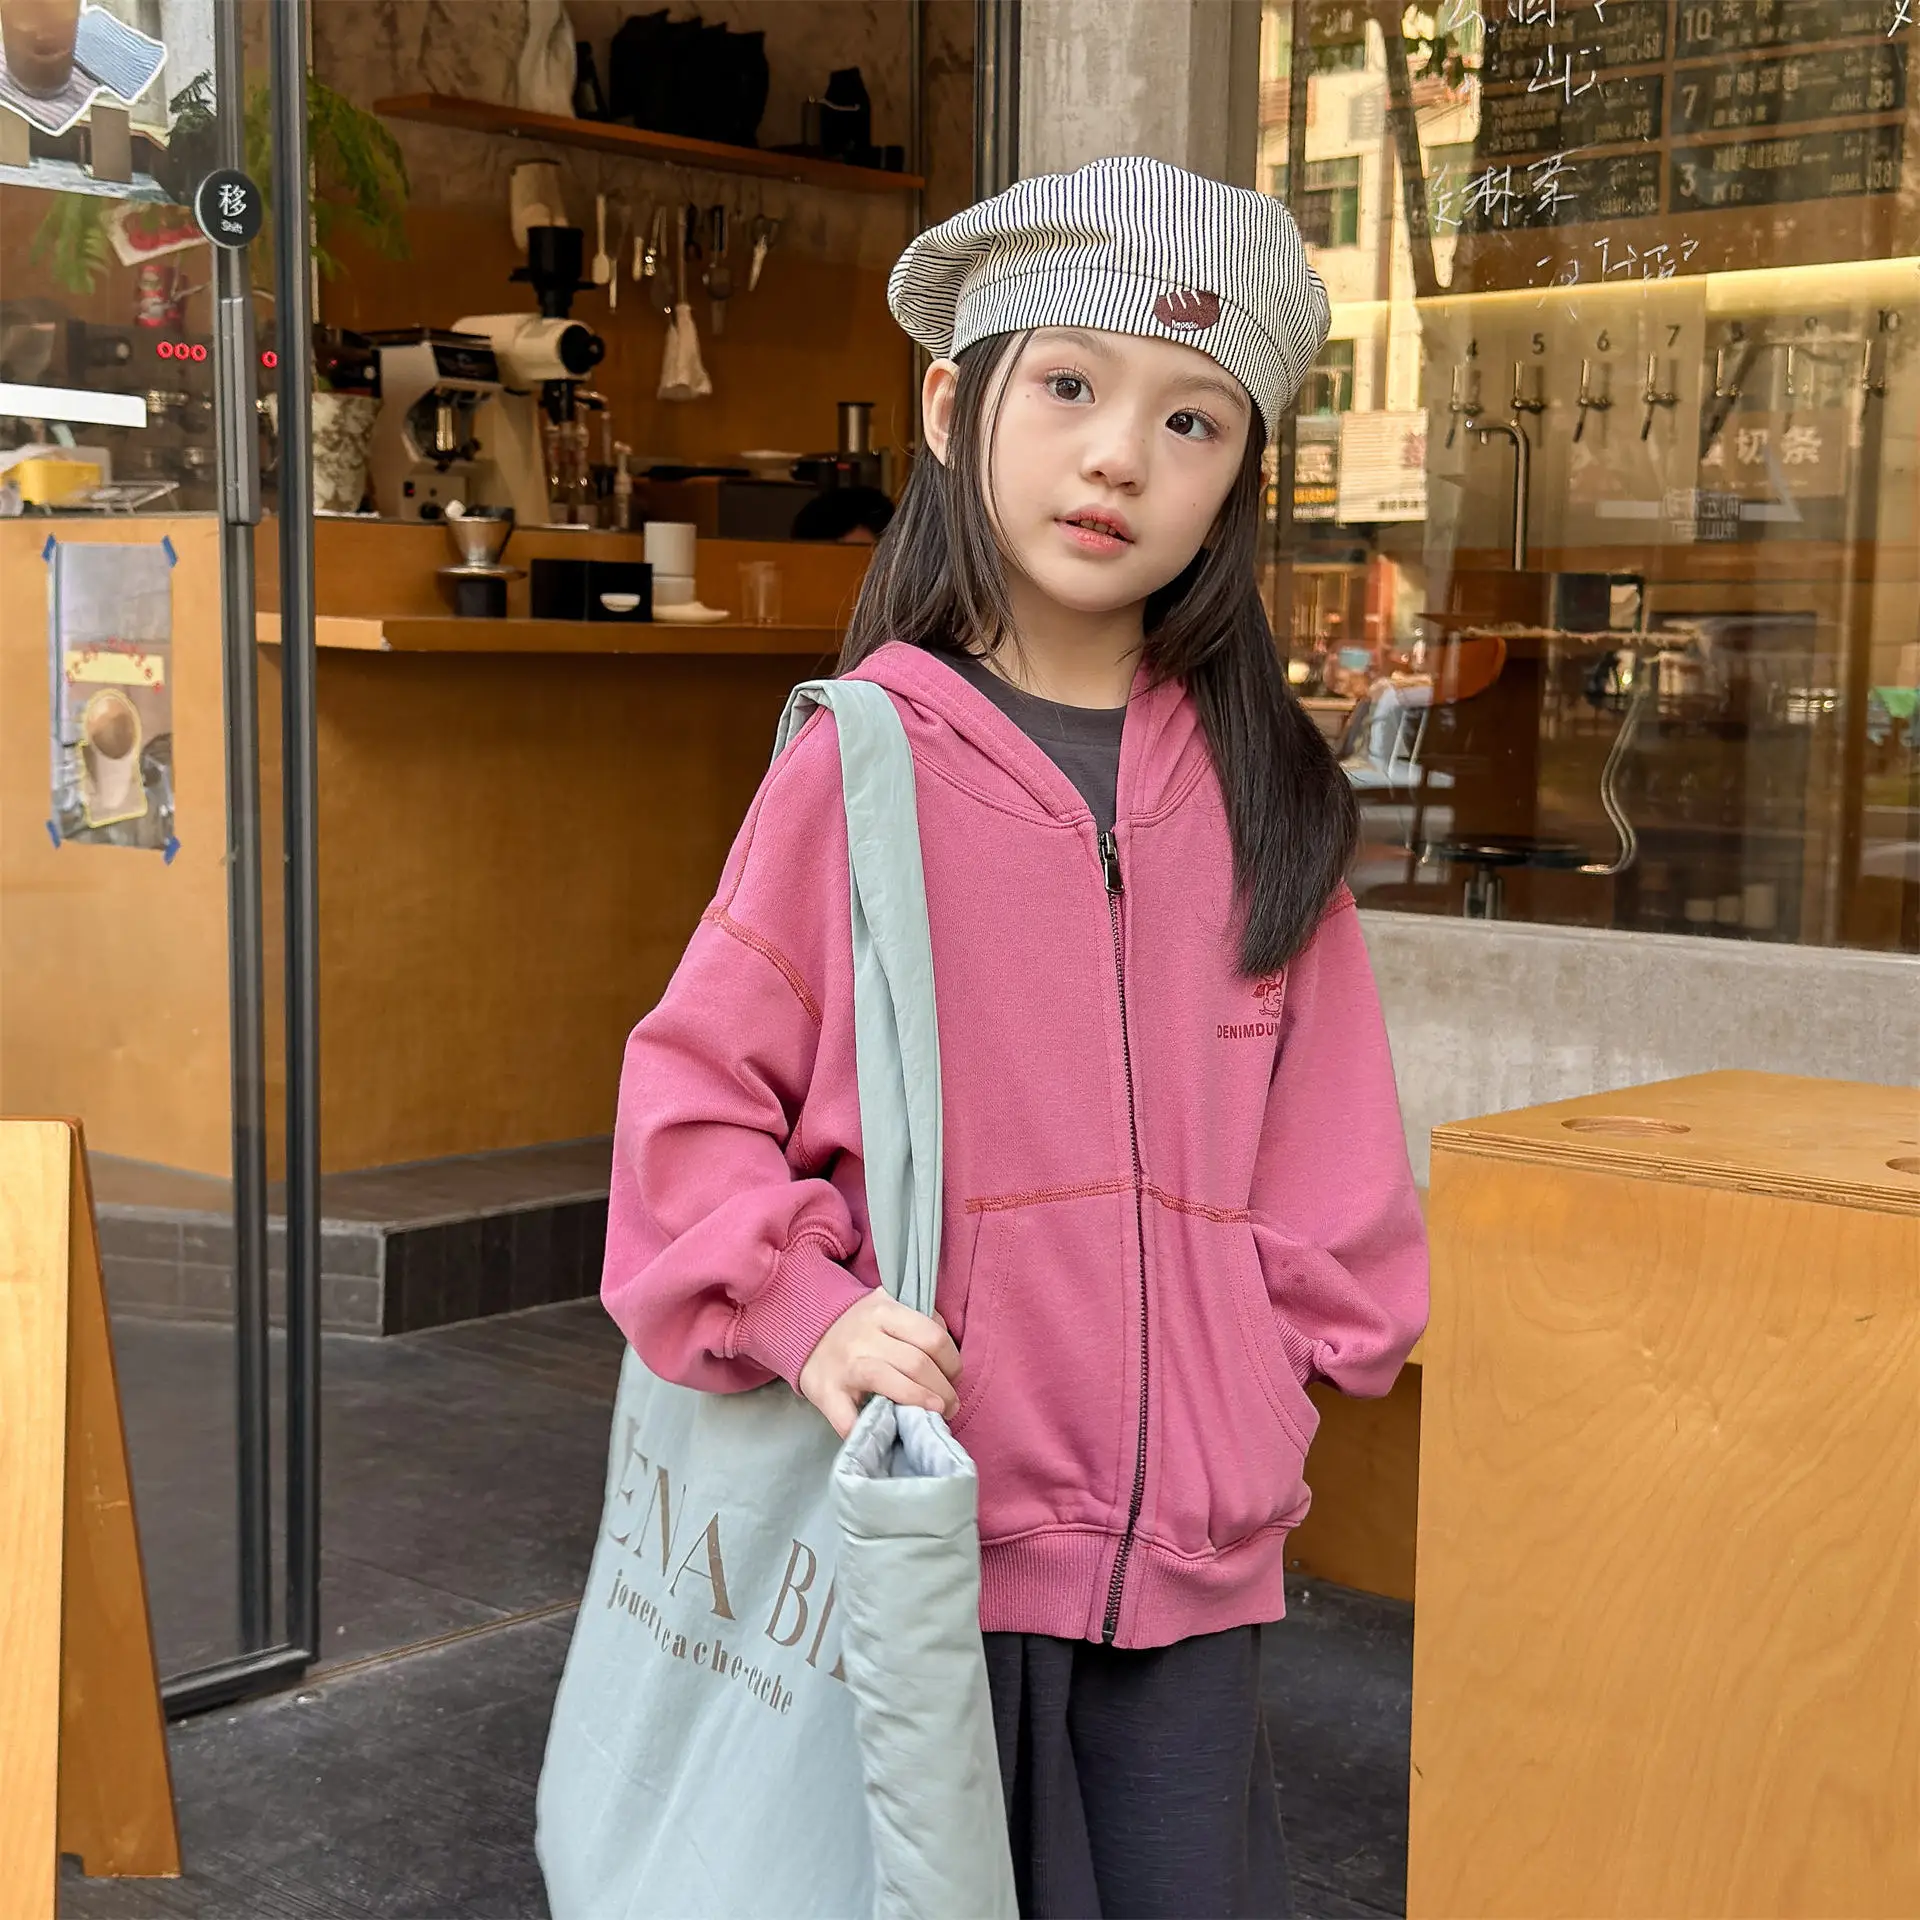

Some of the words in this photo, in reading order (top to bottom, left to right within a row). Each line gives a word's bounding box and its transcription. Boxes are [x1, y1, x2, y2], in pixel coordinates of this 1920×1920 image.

[1683, 9, 1713, 42] 10
[1682, 85, 1698, 119] 7
[1679, 163, 1696, 197] 3
[218, 183, 247, 217] 移
[1532, 332, 1545, 355] 5
[1596, 329, 1610, 352] 6
[1664, 323, 1681, 348] 7
[1878, 308, 1900, 333] 10
